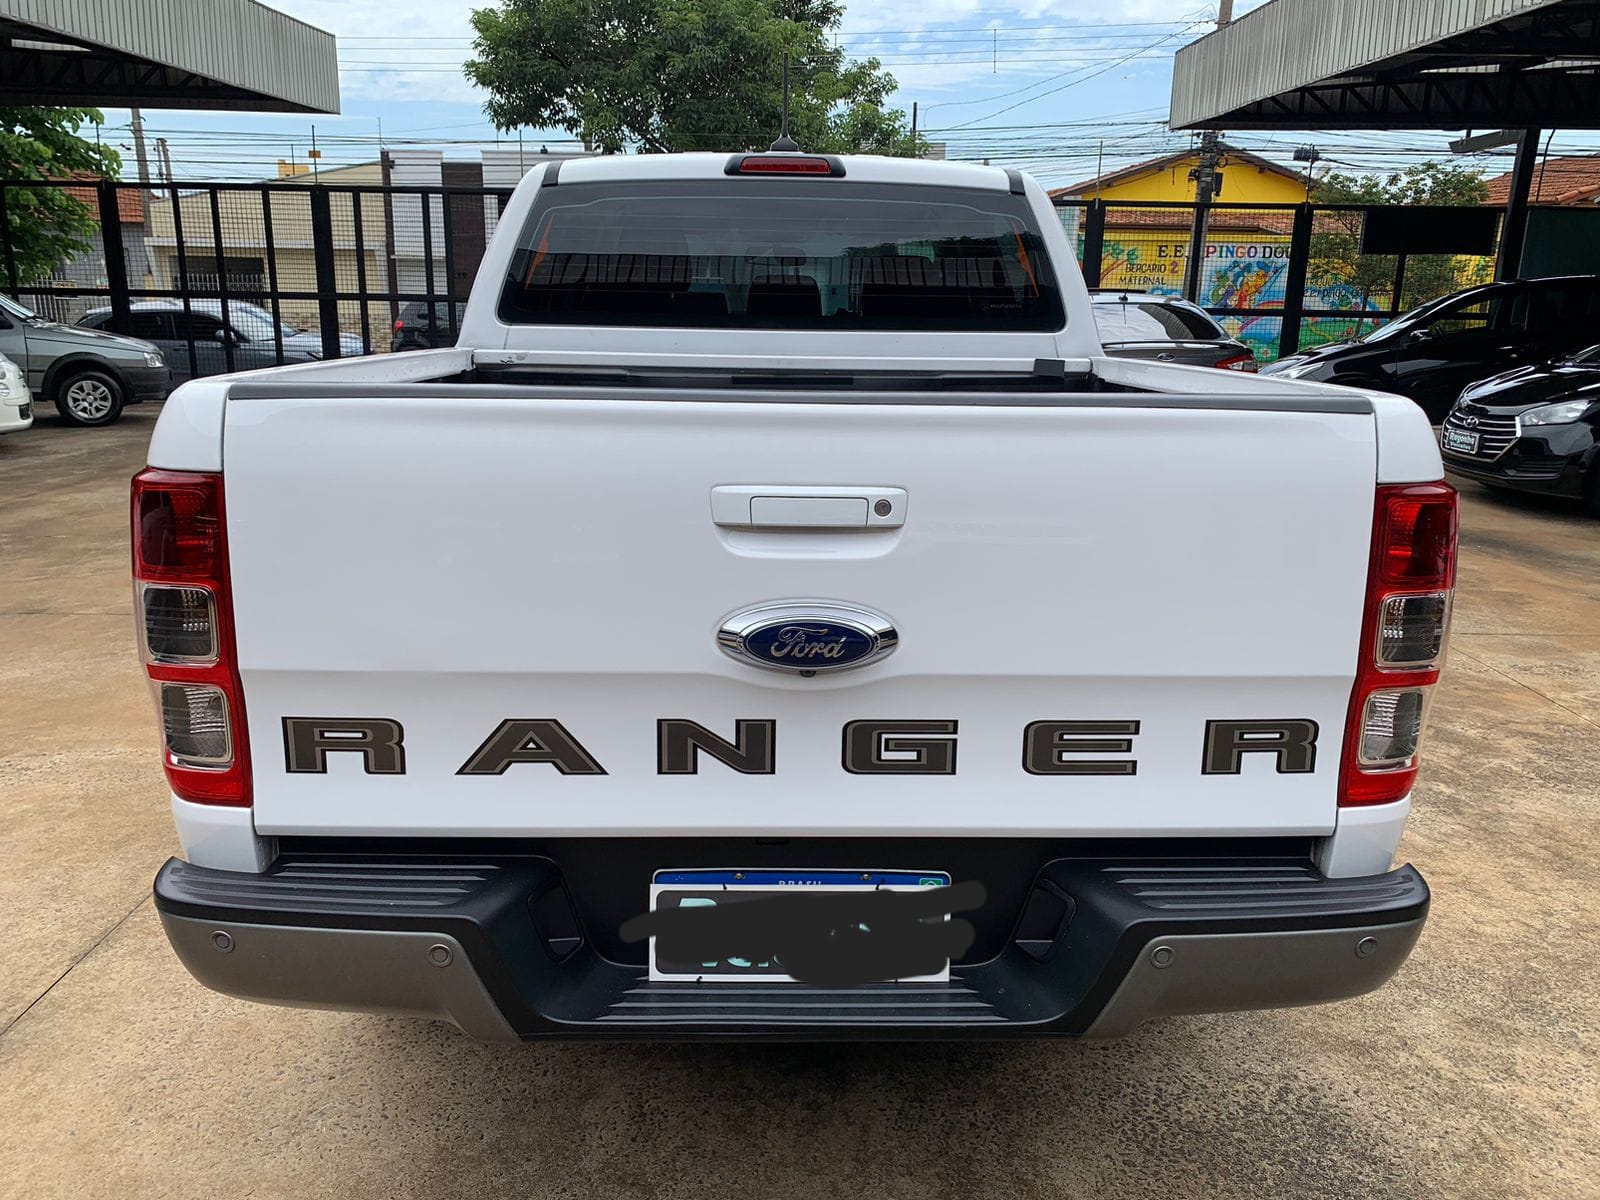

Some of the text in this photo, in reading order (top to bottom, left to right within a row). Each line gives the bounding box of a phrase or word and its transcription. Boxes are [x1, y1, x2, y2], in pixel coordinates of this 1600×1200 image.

[1205, 245, 1257, 258] PINGO
[1170, 260, 1179, 274] 2
[1119, 275, 1166, 285] MATERNAL
[770, 626, 847, 658] Ford
[281, 716, 1320, 776] RANGER
